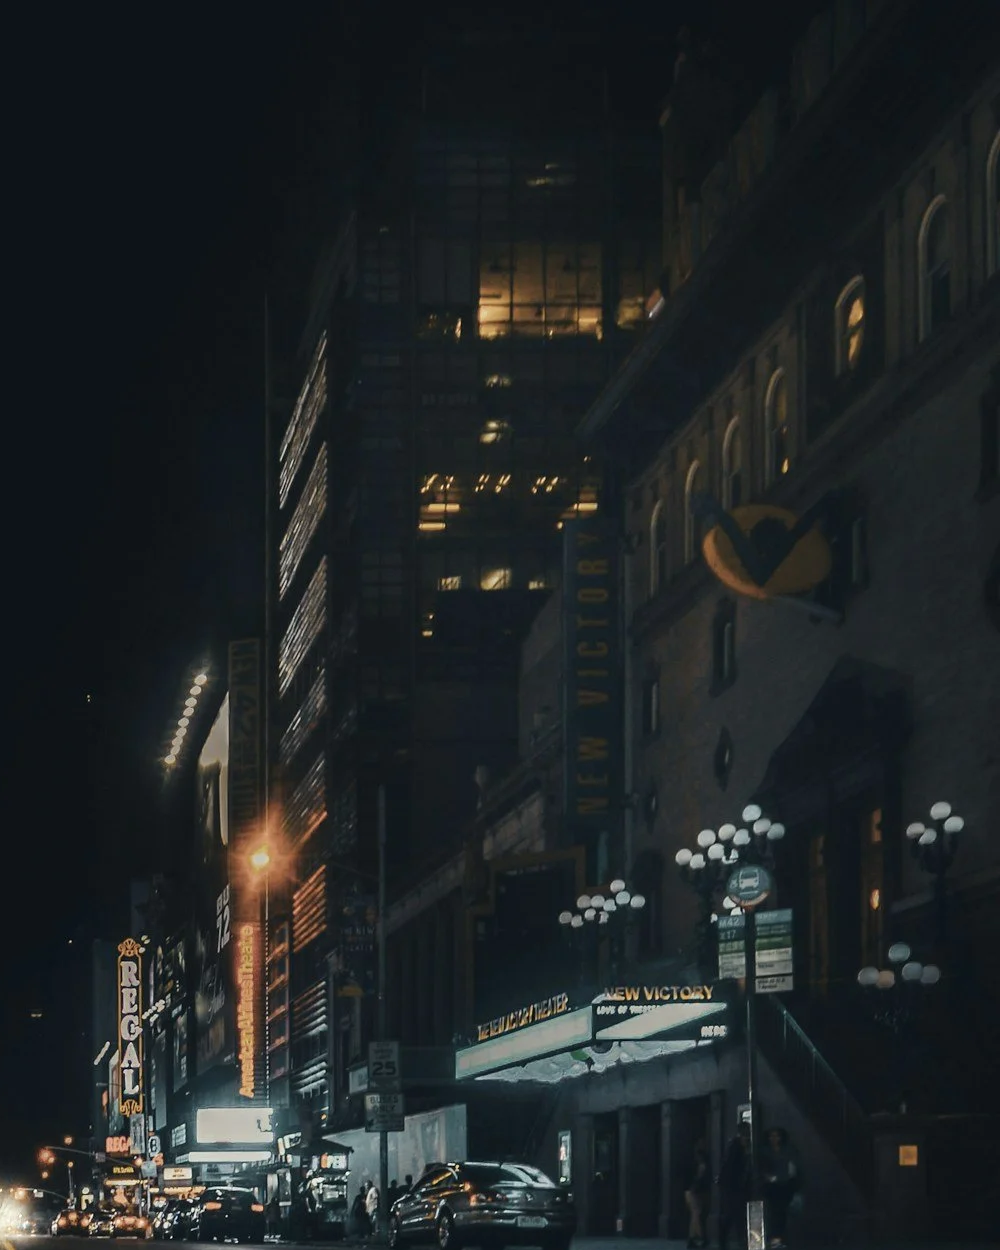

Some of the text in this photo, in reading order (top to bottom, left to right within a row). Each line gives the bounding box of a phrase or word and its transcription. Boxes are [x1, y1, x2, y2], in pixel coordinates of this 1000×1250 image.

[604, 985, 713, 1001] NEW VICTORY
[119, 960, 143, 1095] REGAL
[373, 1061, 396, 1076] 25
